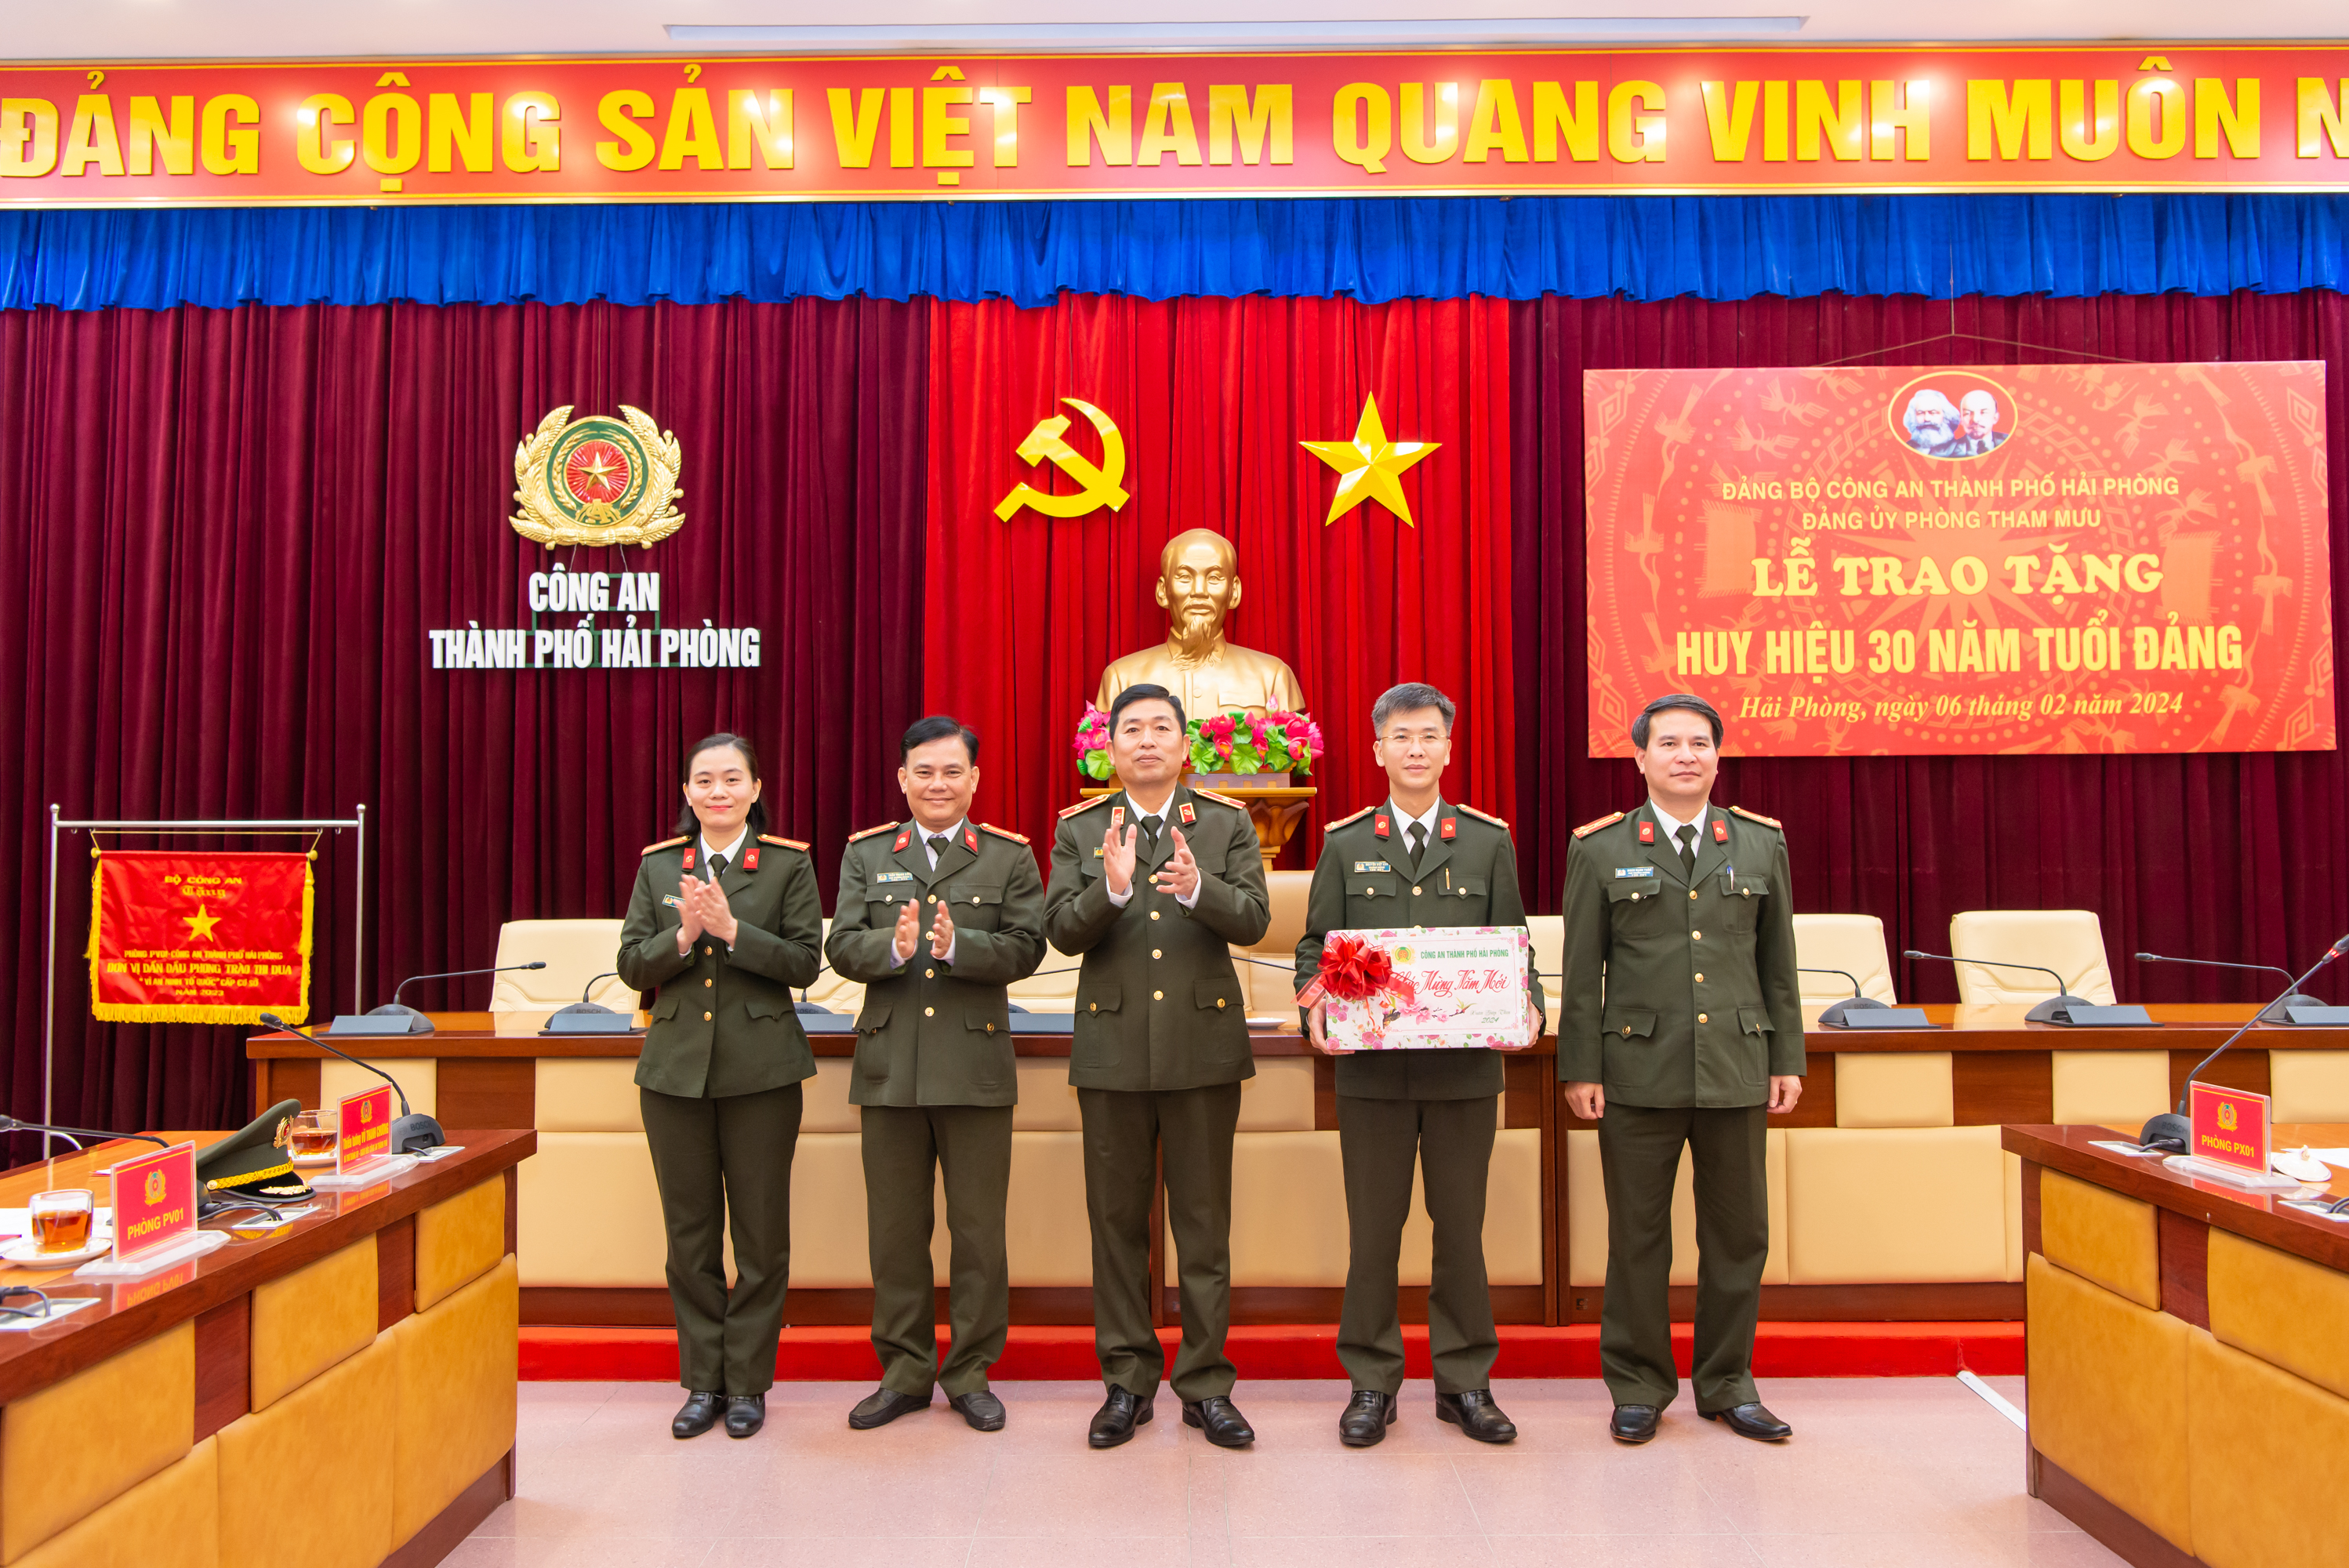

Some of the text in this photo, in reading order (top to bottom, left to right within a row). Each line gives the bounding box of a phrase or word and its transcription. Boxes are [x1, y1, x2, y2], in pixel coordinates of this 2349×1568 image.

[0, 71, 260, 177] ĐẢNG
[297, 72, 561, 192] CỘNG
[596, 64, 793, 172] SẢN
[826, 66, 1032, 185] VIỆT
[1066, 82, 1294, 167] NAM
[1333, 78, 1667, 174] QUANG
[1700, 79, 1931, 162] VINH
[1966, 56, 2261, 162] MUÔN
[1722, 471, 2180, 503] ĐẢNG BỘ CÔNG AN THÀNH PHỐ HẢI PHÒNG
[1802, 505, 2101, 531] ĐẢNG ỦY PHÒNG THAM MƯU
[1750, 536, 2165, 605] LỄ TRAO TẶNG
[528, 562, 660, 612] CÔNG AN
[429, 613, 761, 669] THÀNH PHỐ HẢI PHÒNG
[1676, 608, 2243, 684] HUY HIỆU 30 NĂM TUỔI ĐẢNG
[1738, 691, 2184, 724] Hải Phòng, ngày 06 tháng 02 năm 2024
[187, 874, 221, 885] CÔNG
[192, 949, 202, 959] AN
[1421, 949, 1436, 960] CÔNG
[1437, 950, 1445, 959] AN
[1447, 948, 1465, 958] THÀNH
[1466, 946, 1478, 958] PHỐ
[1490, 947, 1509, 957] PHÒNG
[224, 962, 251, 975] TRÀO
[254, 964, 269, 975] THI
[1414, 970, 1454, 998] Mừng
[1454, 969, 1480, 990] Năm
[1476, 969, 1512, 993] Mới
[409, 1119, 434, 1132] BOSCH
[2202, 1134, 2255, 1158] PHÒNG PX01
[127, 1207, 184, 1240] PHÒNG PV01
